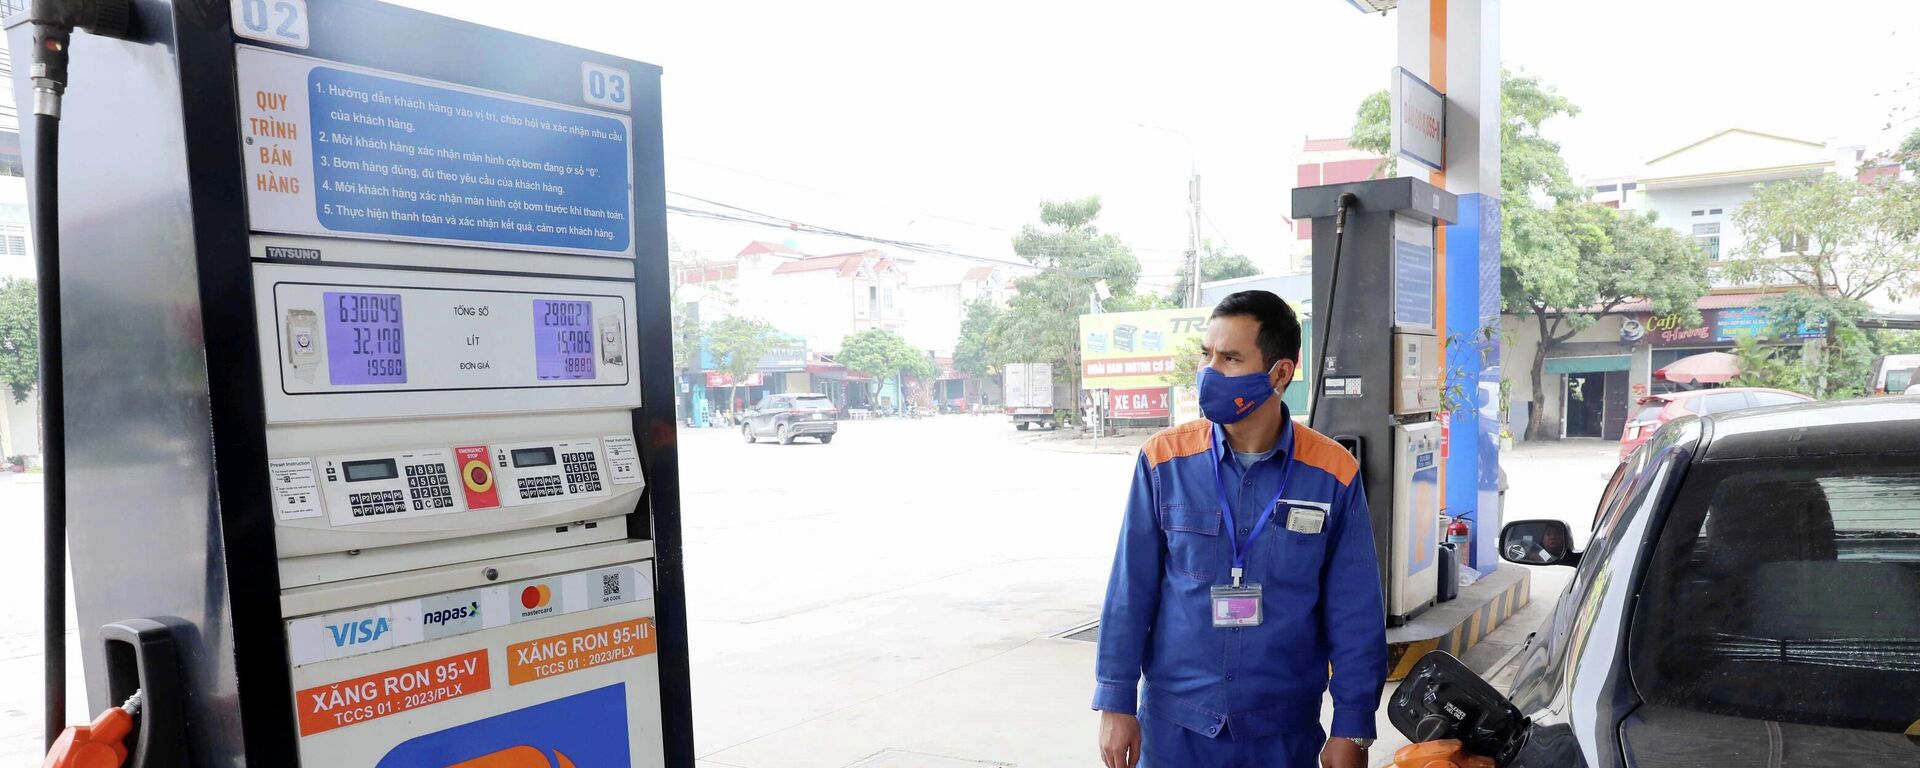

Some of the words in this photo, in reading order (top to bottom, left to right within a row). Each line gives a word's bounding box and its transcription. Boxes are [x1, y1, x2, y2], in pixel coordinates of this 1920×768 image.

[243, 0, 300, 40] 02
[589, 70, 625, 104] 03
[256, 90, 287, 112] QUY
[315, 82, 325, 94] 1.
[329, 84, 368, 102] Hướng
[372, 91, 391, 105] dẫn
[394, 94, 425, 110] khách
[428, 103, 453, 116] hàng
[456, 108, 473, 118] vào
[475, 110, 484, 122] vị
[486, 111, 498, 122] trí,
[501, 113, 522, 126] chào
[540, 121, 551, 130] và
[552, 123, 568, 133] xác
[570, 126, 589, 139] nhận
[592, 129, 607, 139] nhu
[608, 130, 622, 142] cầu
[250, 116, 297, 140] TRÌNH
[330, 111, 350, 121] của
[354, 113, 385, 127] khách
[388, 118, 416, 133] hàng.
[260, 144, 292, 166] BÁN
[319, 132, 328, 142] 2.
[332, 133, 352, 146] Mời
[356, 136, 387, 151] khách
[390, 142, 415, 156] hàng
[417, 146, 434, 156] xác
[437, 148, 461, 161] nhận
[463, 153, 482, 162] màn
[485, 154, 504, 165] hình
[506, 157, 520, 168] cột
[522, 158, 542, 170] bơm
[544, 163, 564, 175] đang
[574, 165, 584, 176] số
[256, 171, 300, 194] HÀNG
[320, 156, 330, 167] 3.
[334, 158, 360, 170] Bơm
[362, 161, 389, 176] hàng
[391, 165, 419, 179] đúng,
[436, 171, 458, 182] theo
[460, 174, 477, 184] yêu
[479, 175, 494, 186] cầu
[497, 177, 512, 187] của
[515, 179, 540, 191] khách
[542, 182, 566, 196] hàng.
[322, 180, 332, 191] 4.
[358, 183, 390, 197] khách
[392, 187, 417, 202] hàng
[420, 191, 436, 201] xác
[439, 193, 462, 205] nhận
[465, 196, 484, 206] màn
[486, 197, 506, 208] hình
[508, 200, 522, 211] cột
[523, 202, 543, 212] bơm
[545, 203, 568, 214] trước
[569, 206, 582, 216] khi
[583, 208, 605, 218] thanh
[607, 210, 625, 220] toán.
[324, 204, 333, 214] 5.
[336, 205, 364, 218] Thực
[367, 207, 389, 221] hiện
[391, 210, 420, 222] thanh
[421, 213, 443, 224] toán
[445, 216, 456, 225] và
[458, 217, 475, 227] xác
[477, 219, 499, 231] nhận
[501, 218, 514, 230] kết
[516, 222, 534, 233] quả,
[556, 226, 567, 234] ơn
[569, 226, 592, 237] khách
[594, 228, 616, 240] hàng.
[268, 248, 319, 260] TATSUNO
[340, 295, 399, 323] 630045
[454, 305, 476, 316] TỔNG
[478, 305, 489, 316] SỐ
[544, 302, 590, 326] 298021
[353, 328, 401, 356] 32,178
[467, 334, 480, 346] LÍT
[367, 359, 402, 376] 19580
[460, 362, 476, 370] ĐƠN
[477, 360, 490, 370] GIÁ
[566, 358, 592, 372] 18880
[1115, 395, 1129, 410] XE
[1133, 394, 1148, 409] GA
[424, 606, 467, 626] napas
[522, 607, 553, 617] mastercard
[325, 617, 388, 647] VISA
[517, 640, 568, 666] XĂNG
[572, 631, 608, 653] RON
[612, 623, 648, 645] 95-III
[534, 661, 564, 677] TCCS
[567, 658, 579, 669] 01
[589, 645, 634, 665] 2023/PLX
[312, 682, 378, 713] XĂNG
[384, 669, 430, 696] RON
[436, 657, 478, 683] 95-V
[334, 707, 373, 725] TCCS
[378, 702, 392, 714] 01
[405, 683, 463, 708] 2023/PLX
